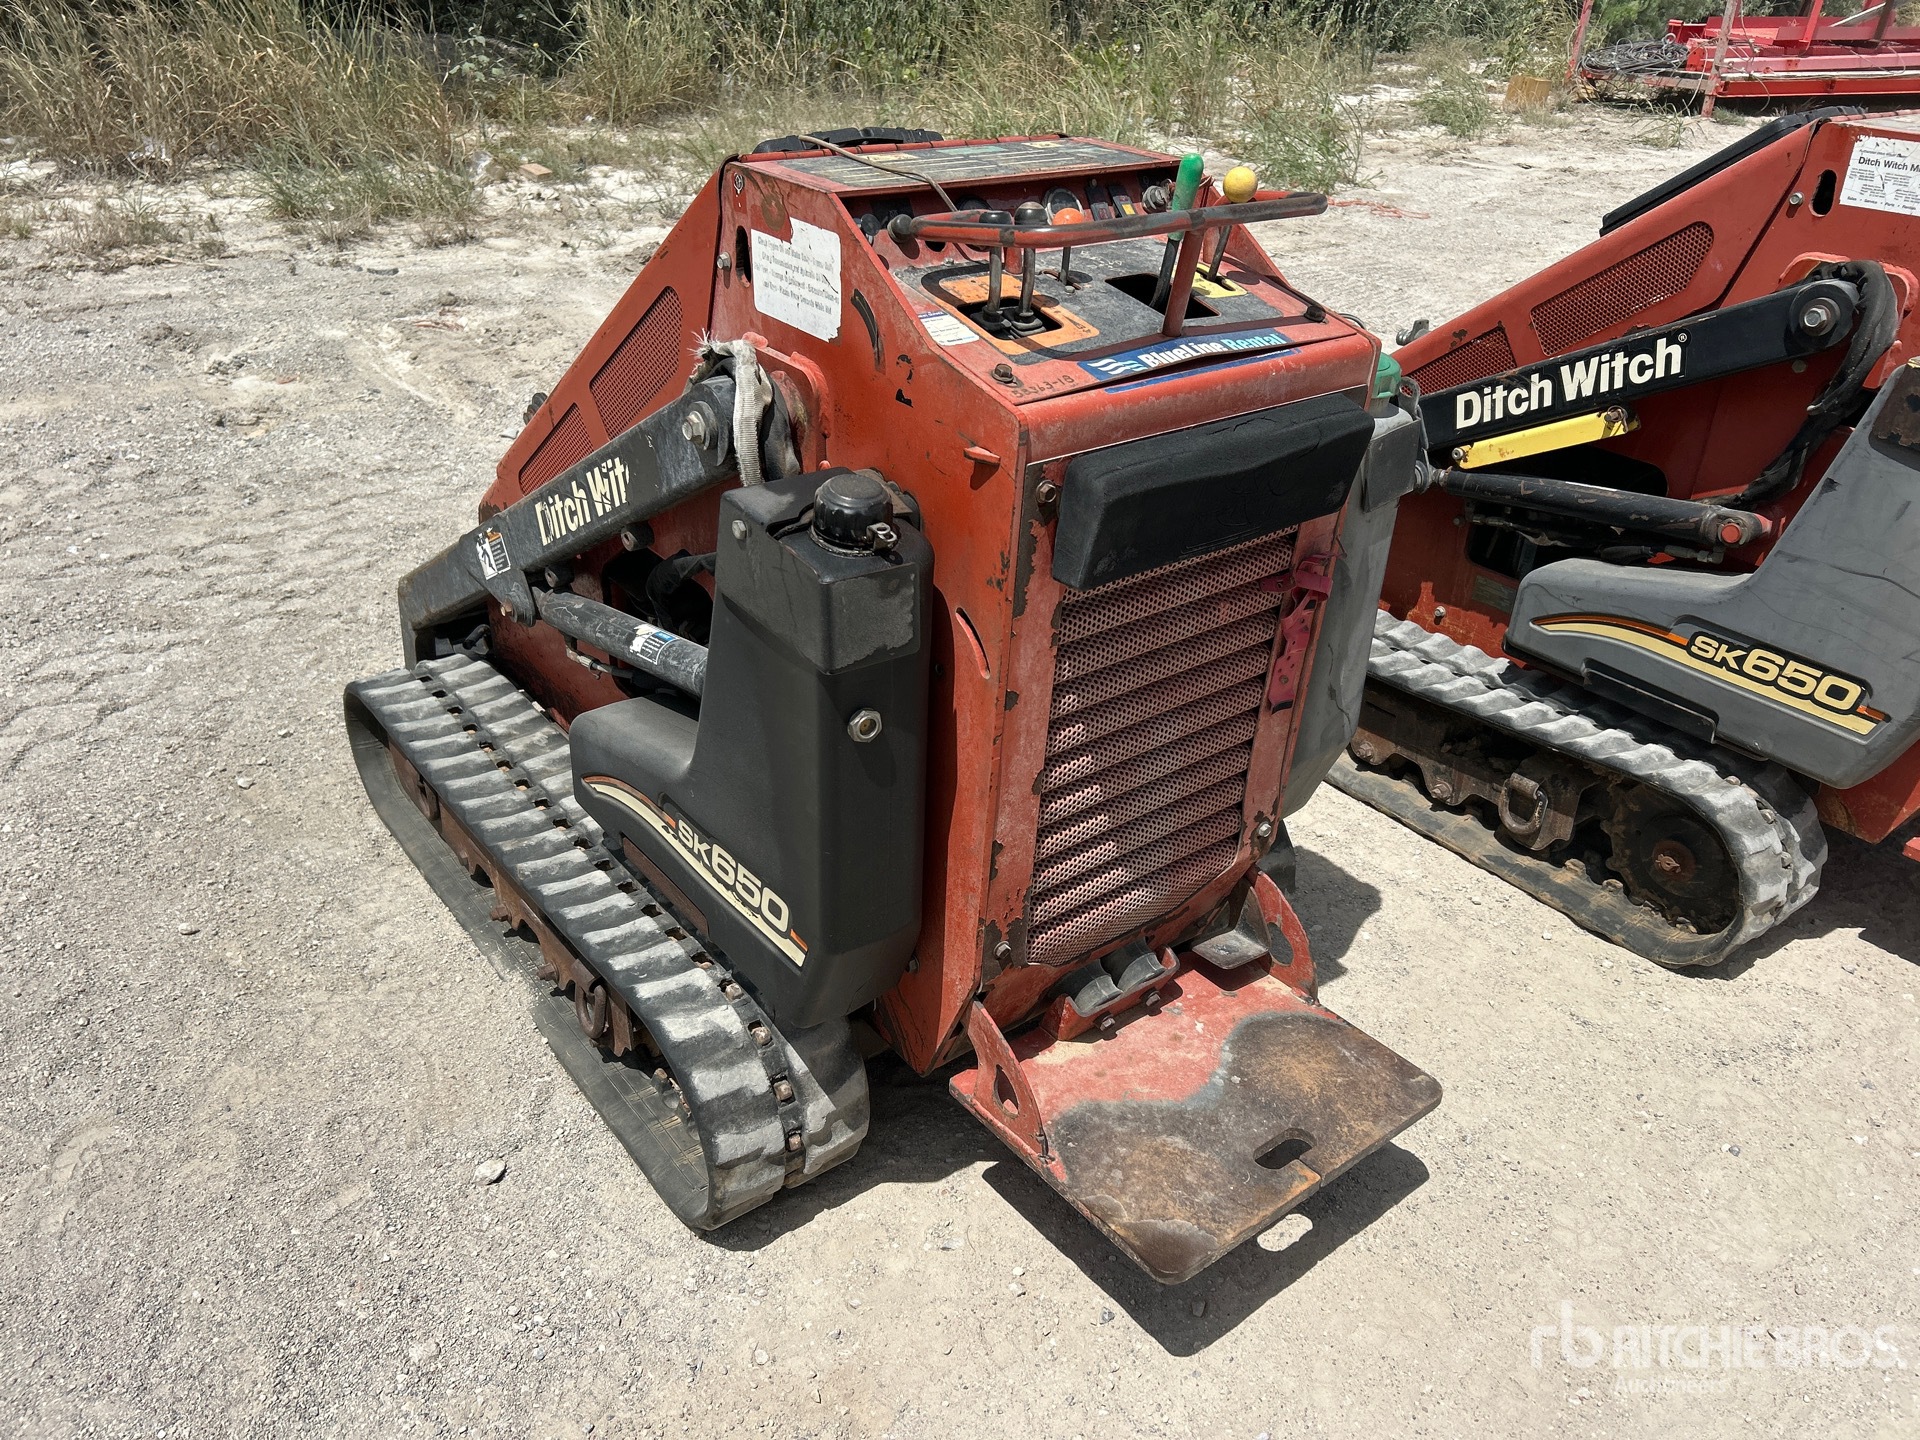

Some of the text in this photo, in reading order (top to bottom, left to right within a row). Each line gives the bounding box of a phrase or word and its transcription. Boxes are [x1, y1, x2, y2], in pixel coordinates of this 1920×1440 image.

[1858, 156, 1880, 167] Ditch
[1884, 160, 1908, 171] Witch
[1138, 334, 1287, 368] BlueLine Rental
[1456, 337, 1682, 429] Ditch Witch
[535, 456, 630, 546] Ditch Wit
[1690, 635, 1863, 711] SK650
[678, 819, 790, 932] SK650
